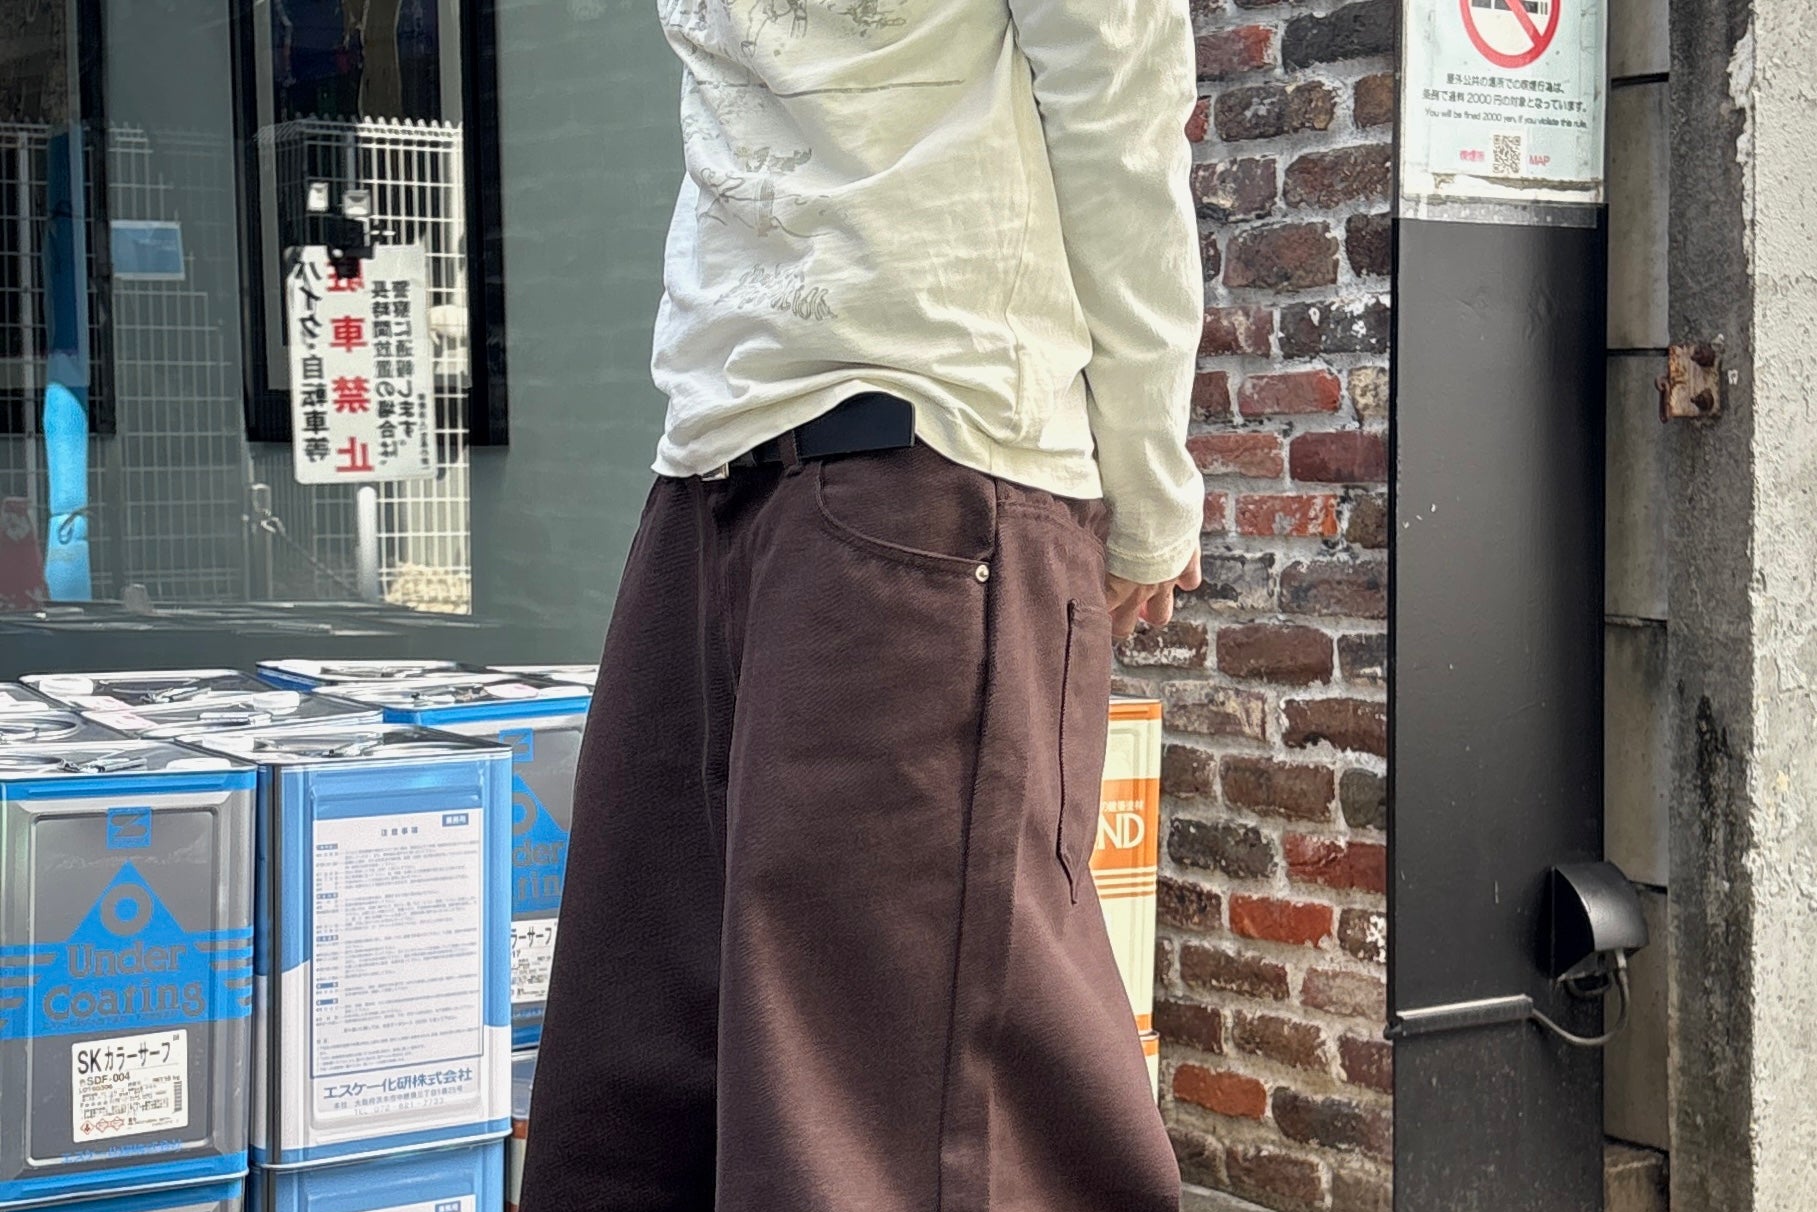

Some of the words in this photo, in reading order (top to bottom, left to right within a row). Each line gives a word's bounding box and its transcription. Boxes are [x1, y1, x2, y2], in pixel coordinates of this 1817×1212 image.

[1425, 108, 1439, 117] You
[1441, 109, 1451, 118] will
[1453, 110, 1462, 119] be
[1464, 111, 1481, 120] fined
[1482, 112, 1502, 122] 2000
[1529, 155, 1550, 166] MAP
[512, 838, 563, 868] der
[511, 926, 552, 949] ラーサーフ
[66, 940, 186, 979] Under
[43, 978, 206, 1021] Coating
[323, 1067, 473, 1100] エスケー化研株式会社
